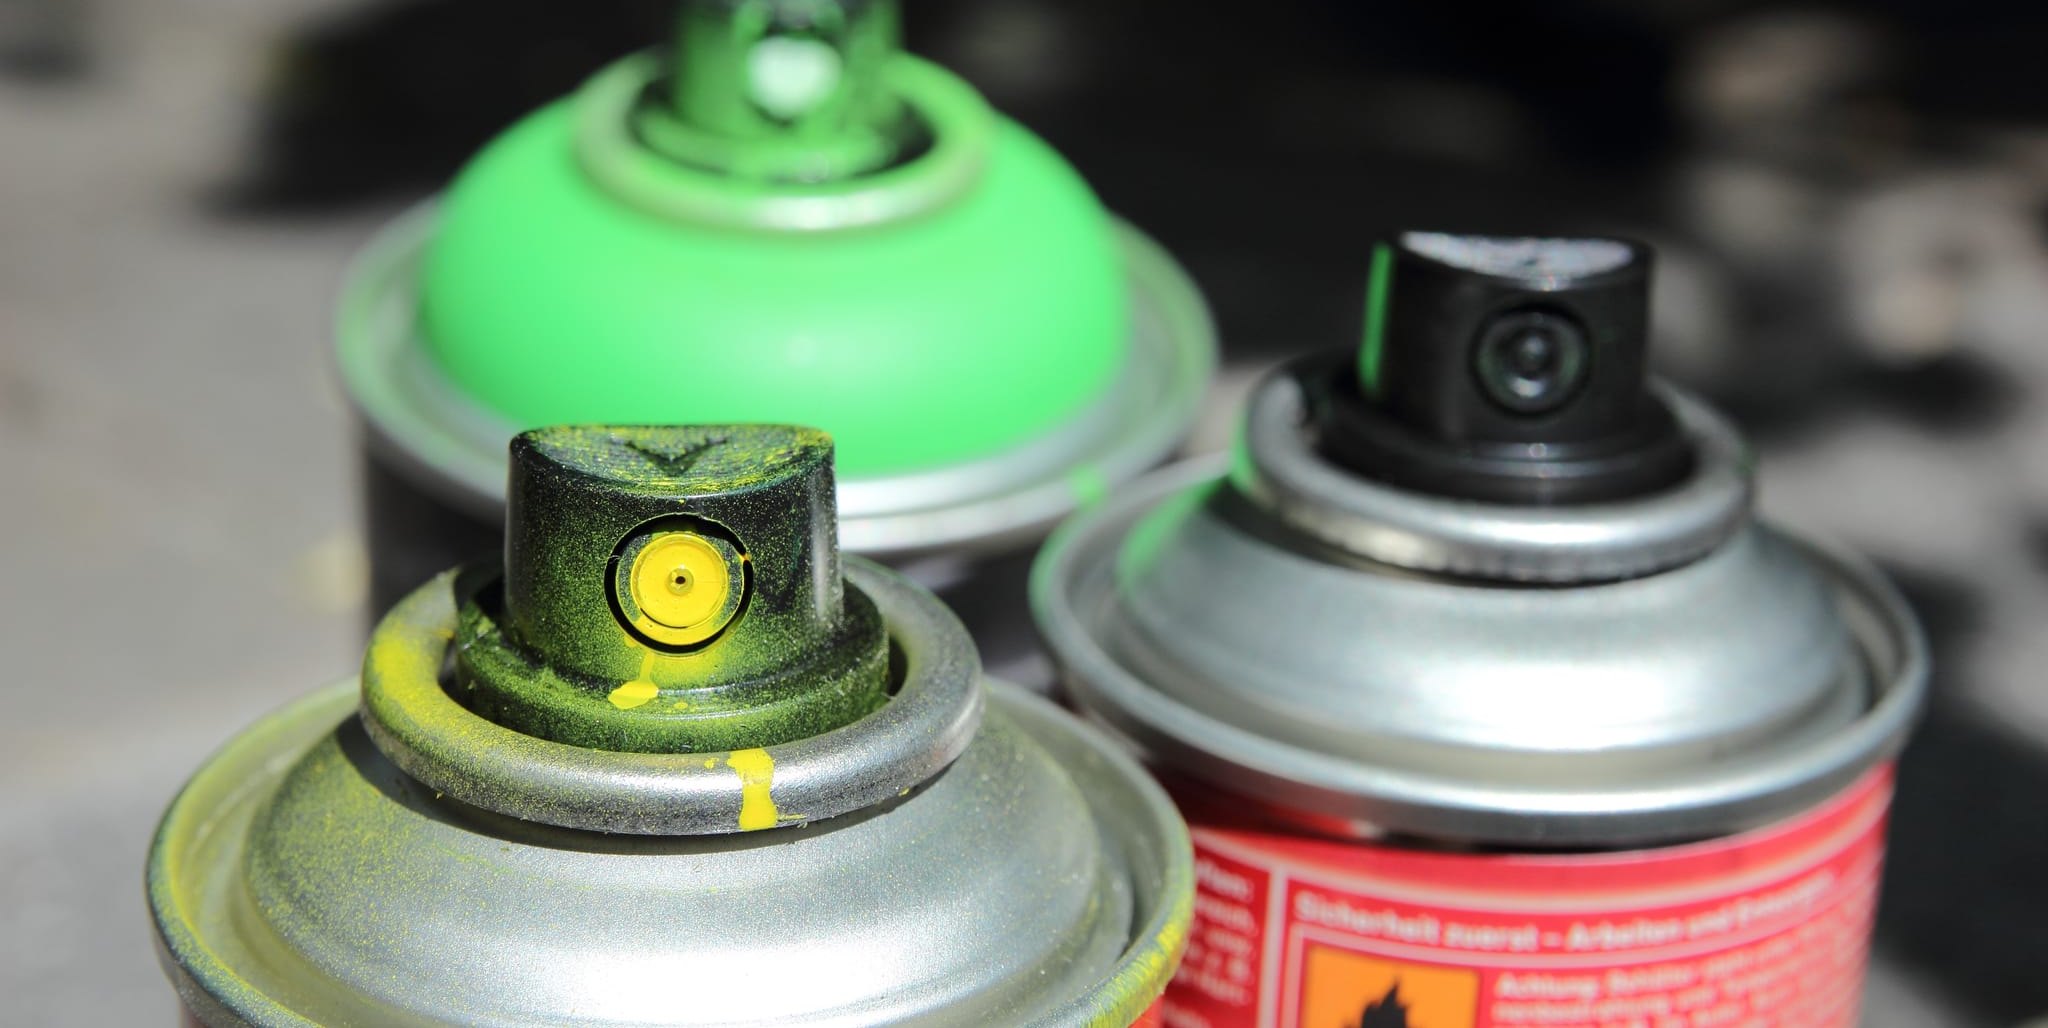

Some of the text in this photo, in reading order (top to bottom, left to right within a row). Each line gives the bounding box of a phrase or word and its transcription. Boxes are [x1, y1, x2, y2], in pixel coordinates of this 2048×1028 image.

[1294, 891, 1440, 945] Sicherheit
[1443, 922, 1538, 951] zuerst
[1568, 919, 1684, 950] Arbeiten
